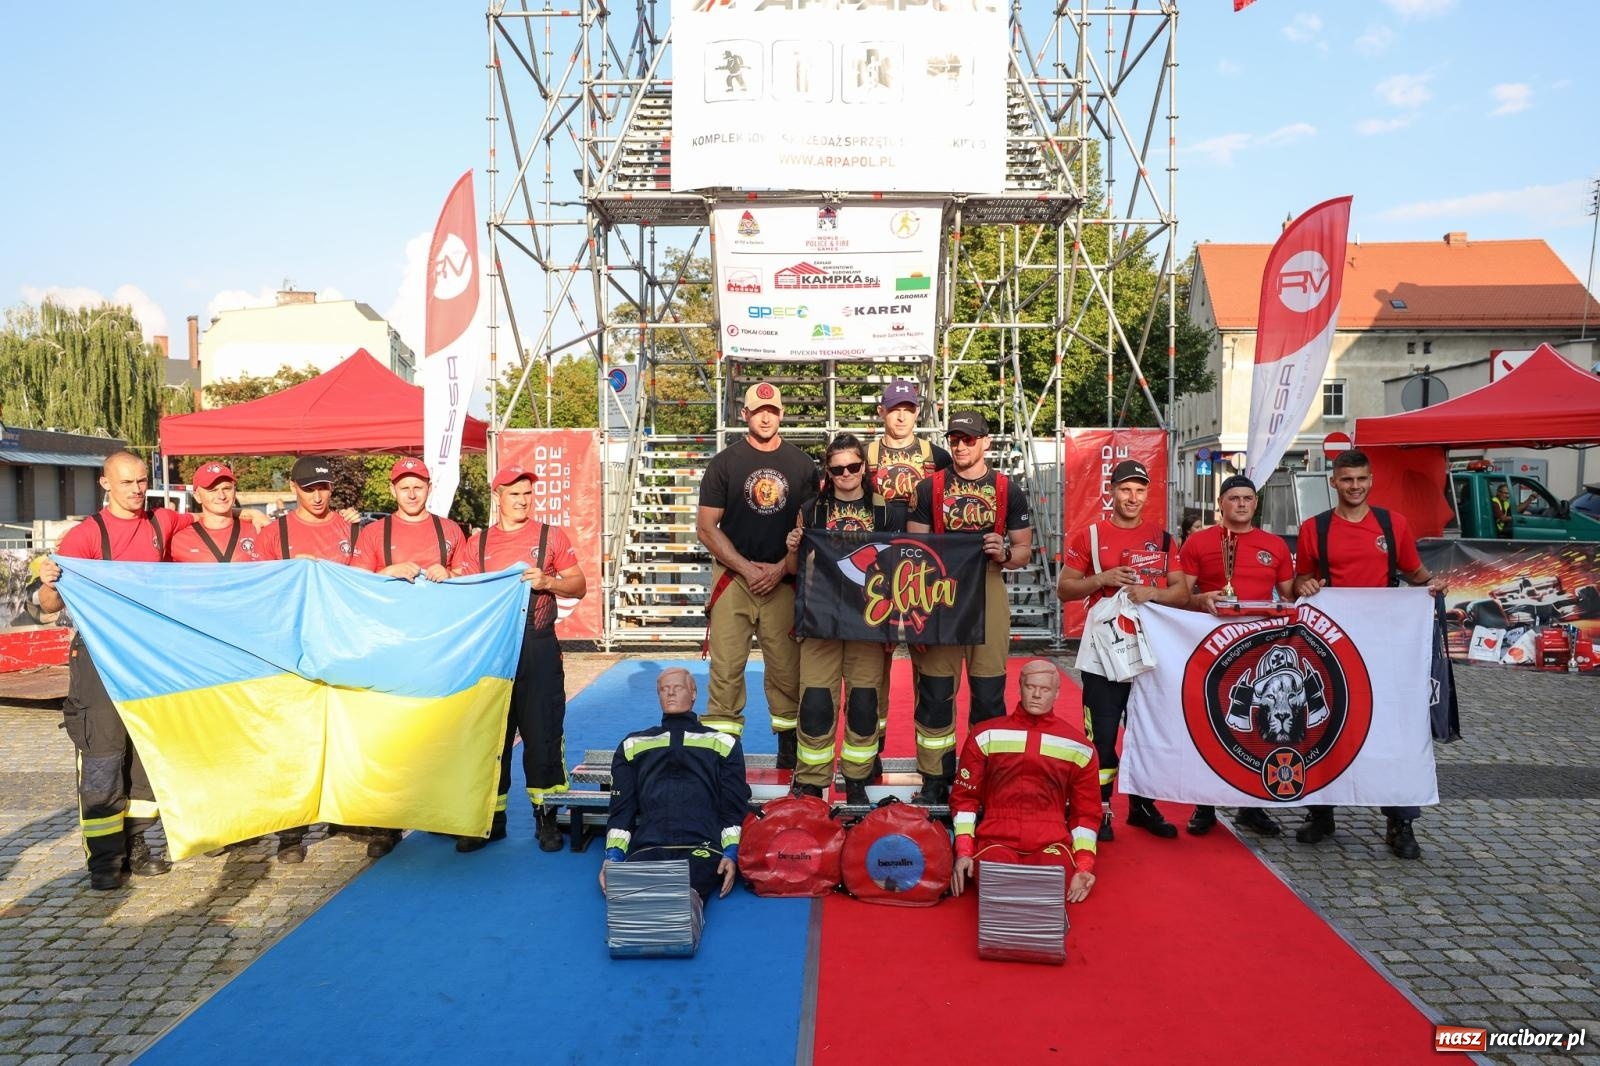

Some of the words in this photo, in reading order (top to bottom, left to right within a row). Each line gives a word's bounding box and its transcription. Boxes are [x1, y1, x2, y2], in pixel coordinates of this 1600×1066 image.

[778, 154, 896, 168] WWW.ARPAPOL.PL
[802, 274, 863, 284] KAMPKA
[865, 276, 881, 285] Sp.j.
[854, 304, 912, 316] KAREN
[535, 445, 547, 524] EKORD
[549, 446, 562, 526] ESCUE
[882, 472, 915, 499] Elit
[949, 502, 996, 530] Elita
[900, 548, 923, 558] FCC
[864, 560, 957, 626] Elita
[1296, 605, 1343, 645] ЛЕВИ
[1220, 641, 1252, 668] firefighter
[1232, 744, 1261, 767] Ukraine
